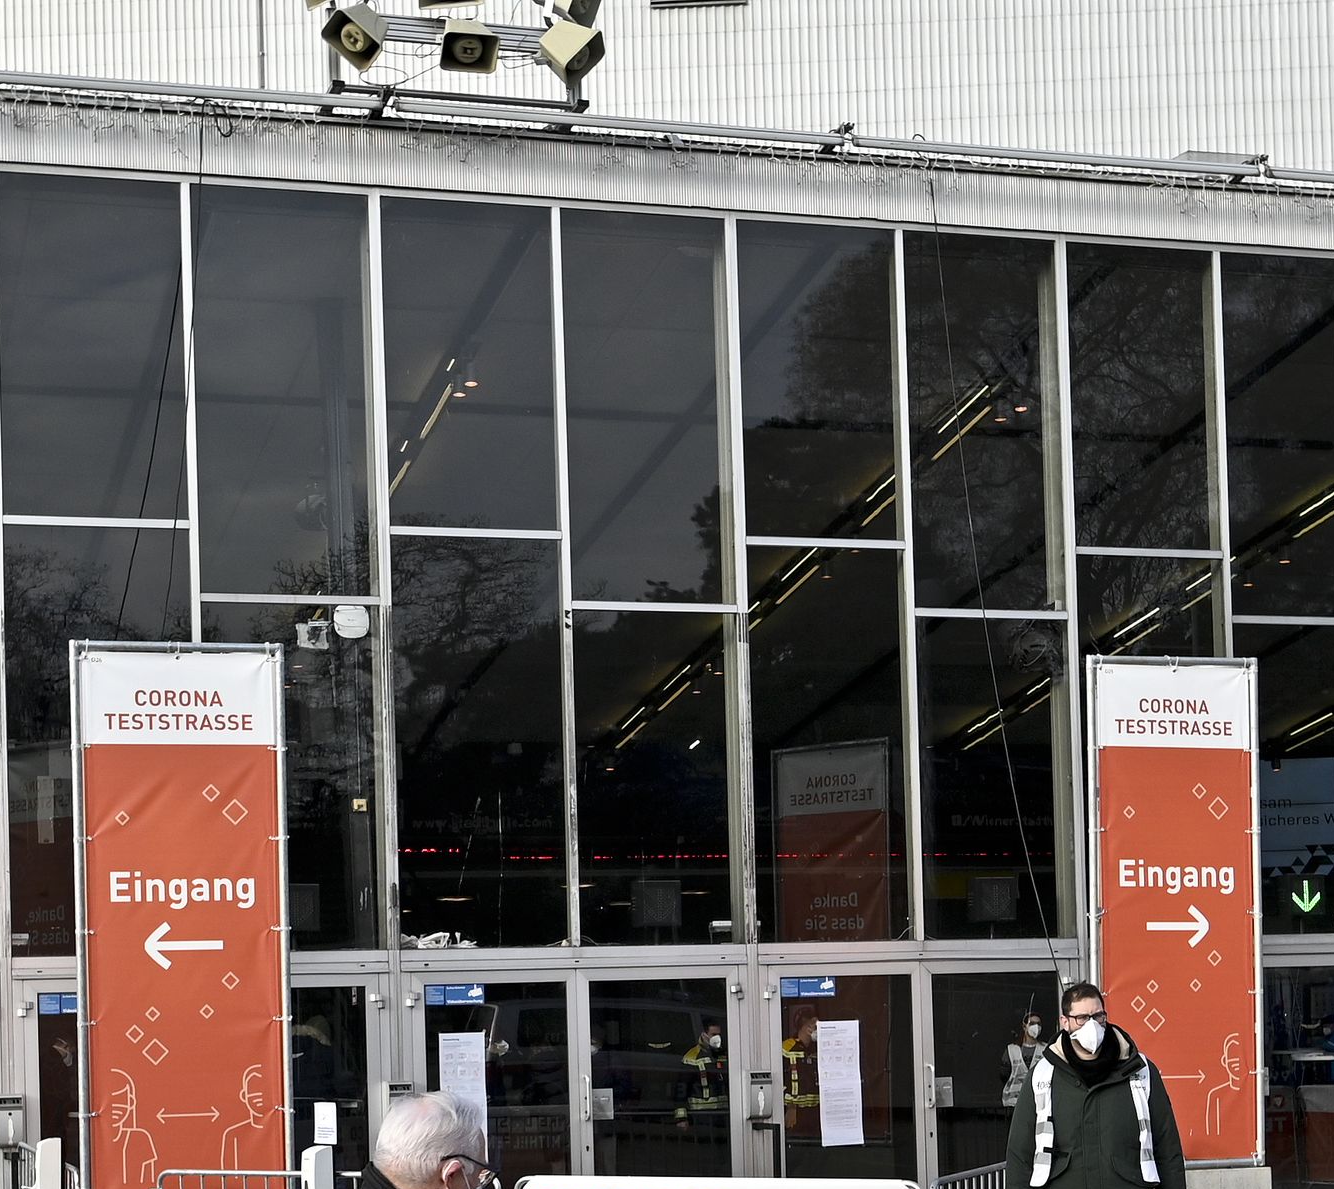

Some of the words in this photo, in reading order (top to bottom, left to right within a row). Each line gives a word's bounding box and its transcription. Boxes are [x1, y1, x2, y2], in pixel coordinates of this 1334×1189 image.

[134, 689, 224, 707] CORONA
[1139, 698, 1209, 715] CORONA
[104, 713, 254, 731] TESTSTRASSE
[1115, 718, 1233, 737] TESTSTRASSE
[1118, 859, 1235, 895] Eingang
[109, 871, 256, 910] Eingang
